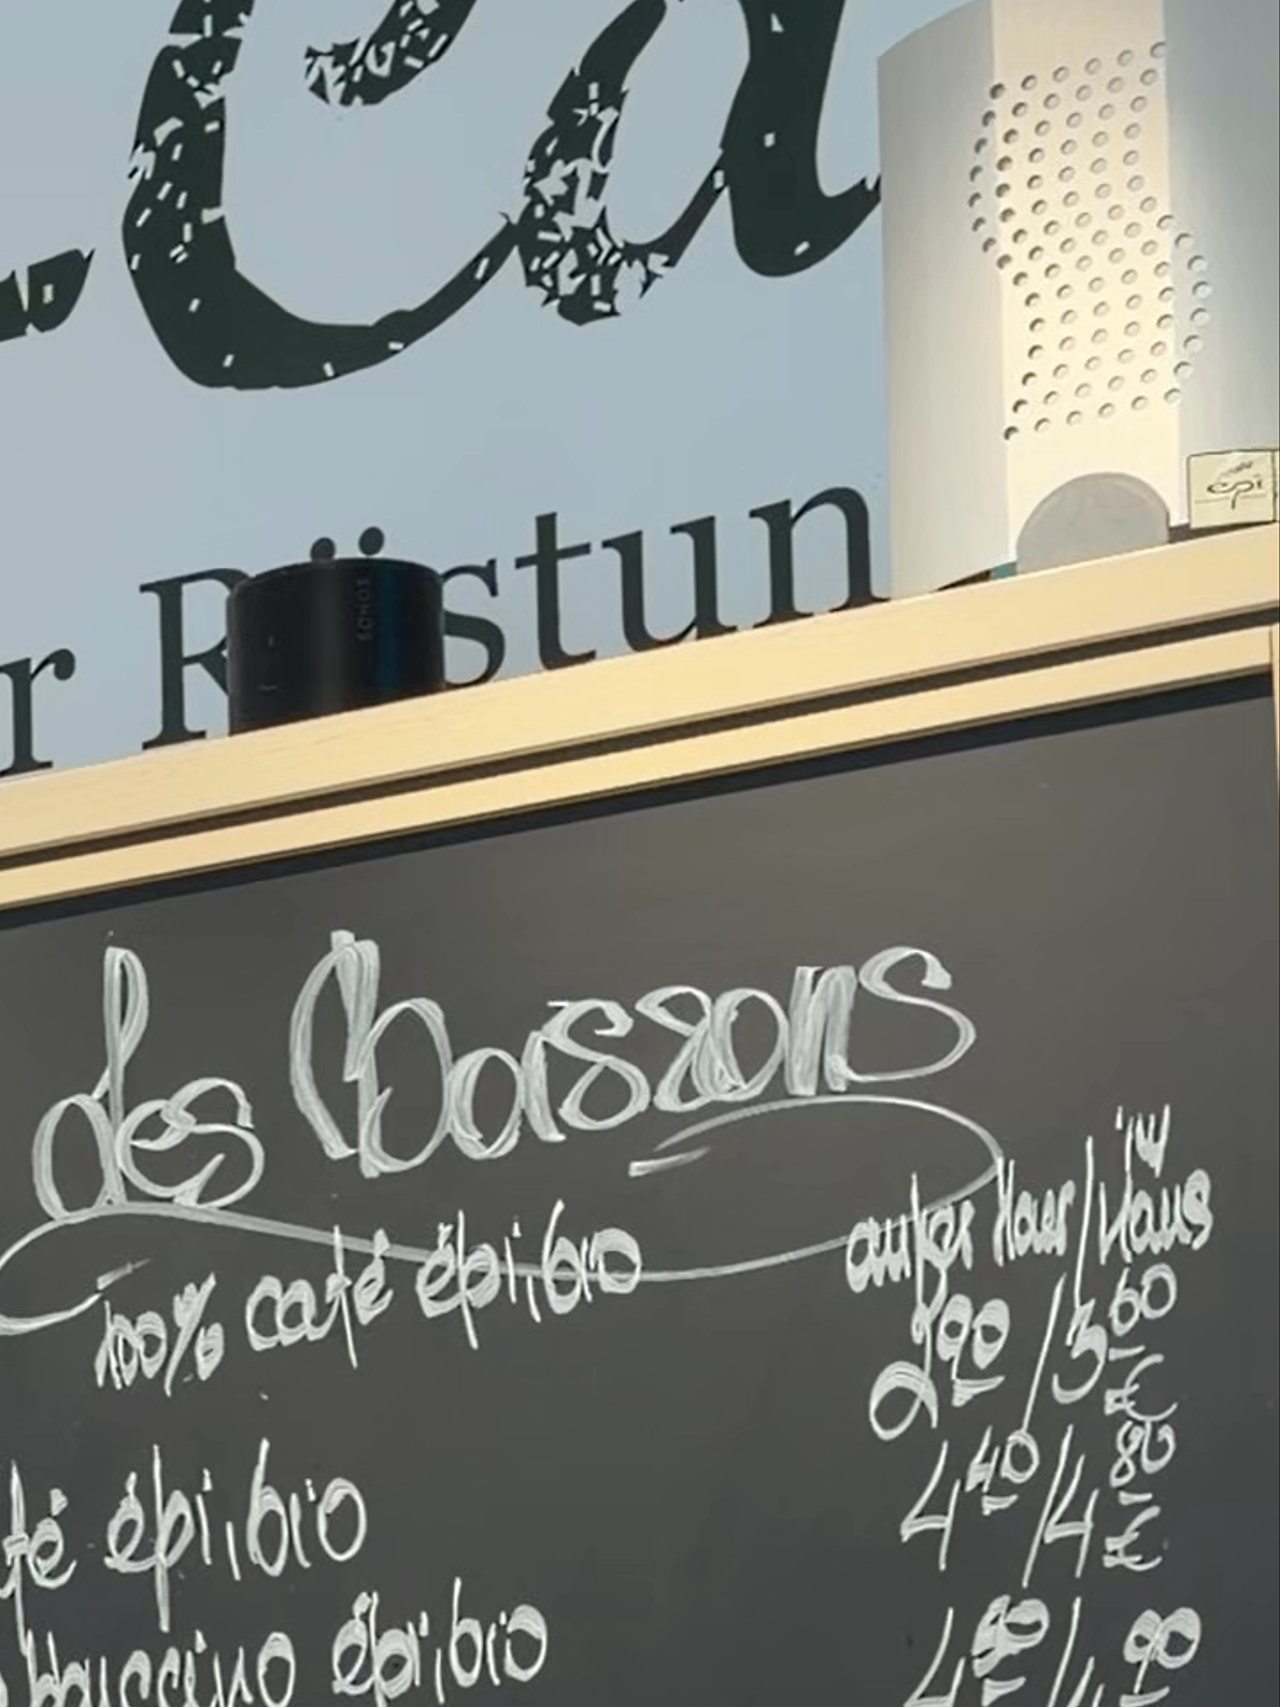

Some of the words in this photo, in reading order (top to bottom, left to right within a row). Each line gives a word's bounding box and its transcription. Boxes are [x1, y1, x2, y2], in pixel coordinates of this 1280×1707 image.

[139, 486, 891, 750] Rstun
[355, 577, 374, 641] SONOS
[94, 1273, 225, 1397] 100%
